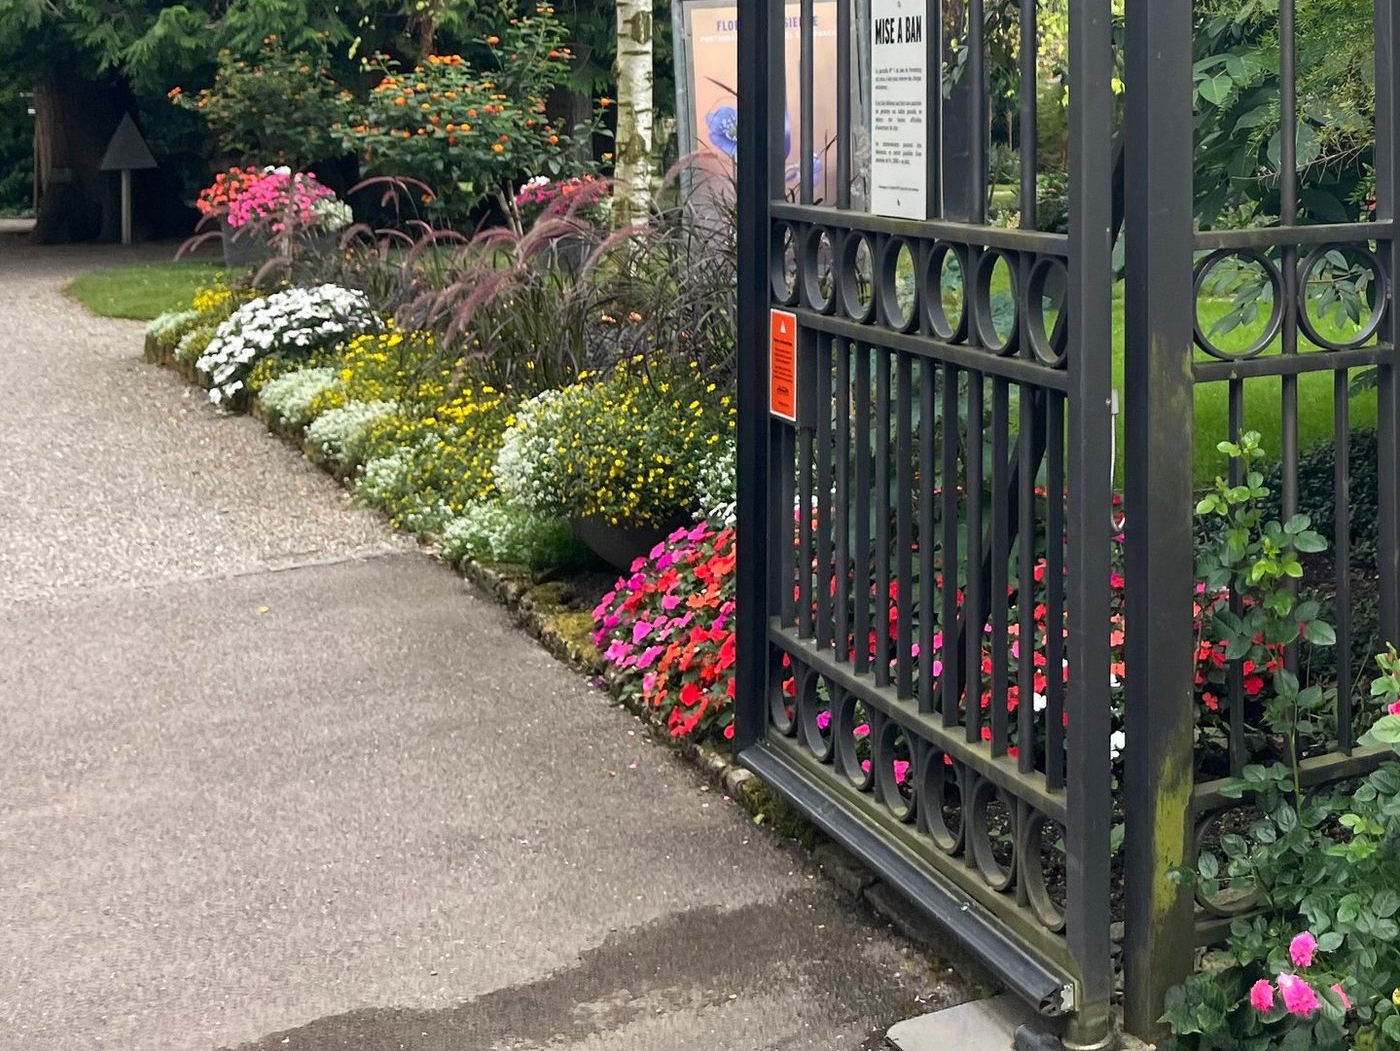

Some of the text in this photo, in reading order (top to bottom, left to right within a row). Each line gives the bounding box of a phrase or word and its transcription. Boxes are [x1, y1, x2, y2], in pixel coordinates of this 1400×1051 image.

[875, 16, 921, 44] MISE A BAN
